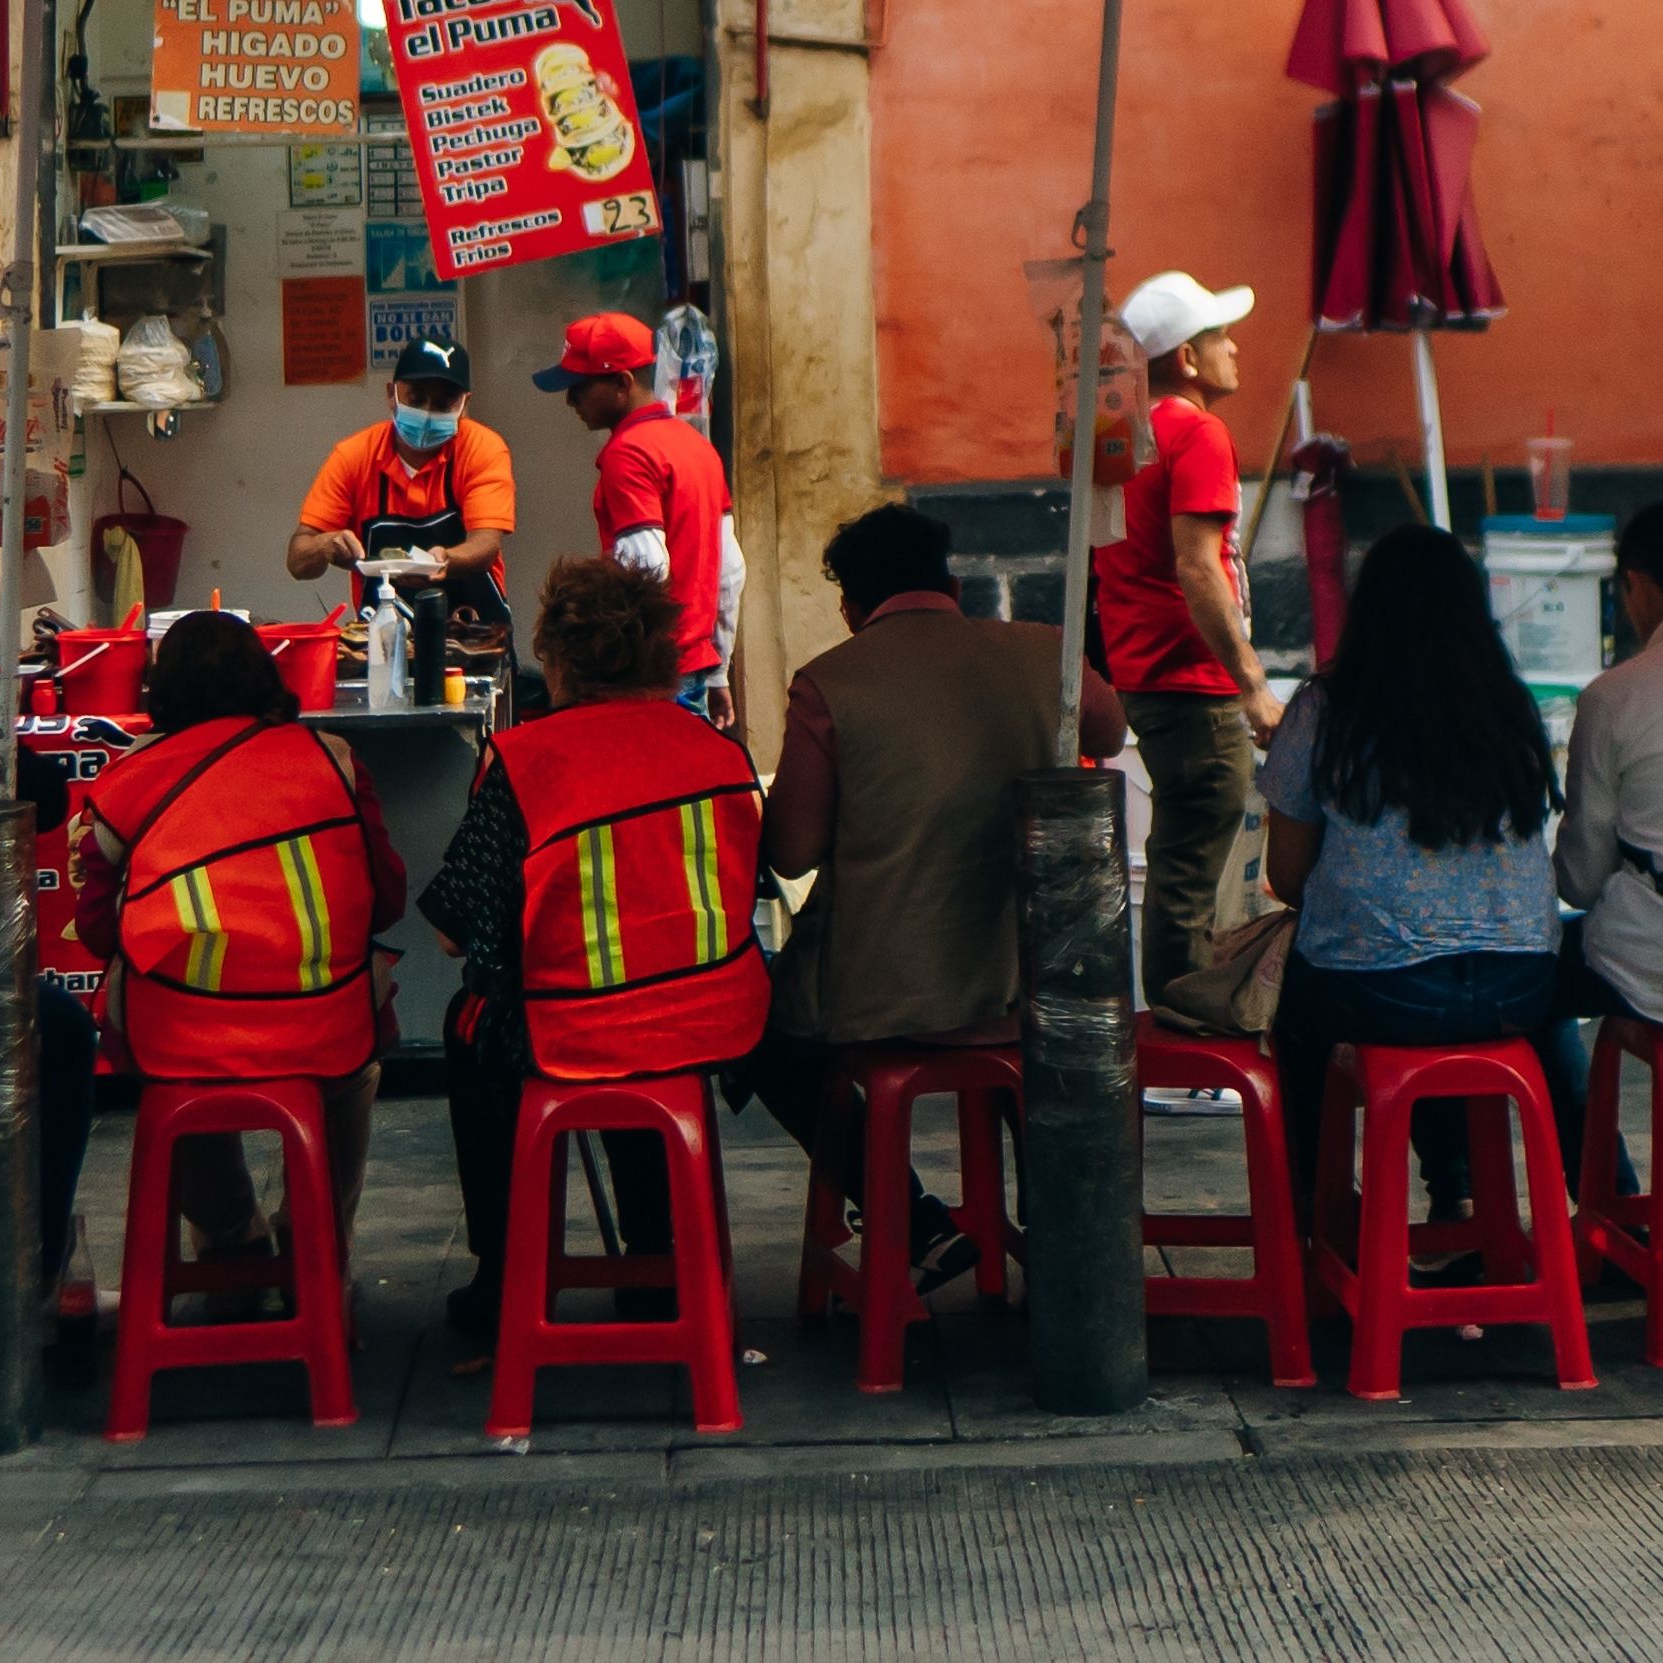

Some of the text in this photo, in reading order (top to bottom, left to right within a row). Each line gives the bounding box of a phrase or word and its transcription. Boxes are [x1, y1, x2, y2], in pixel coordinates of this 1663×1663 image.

[202, 30, 347, 59] HIGADO
[405, 5, 560, 60] el Puma
[200, 63, 329, 91] HUEVO
[420, 69, 527, 104] Suadero
[198, 96, 354, 125] REFRESCOS
[426, 98, 511, 129] Bistek
[431, 118, 541, 155] Pechuga
[436, 146, 523, 180] Pastor
[441, 176, 507, 206] Tripa
[449, 209, 562, 246] Refrescos
[603, 196, 651, 233] 23
[453, 242, 512, 268] Frios
